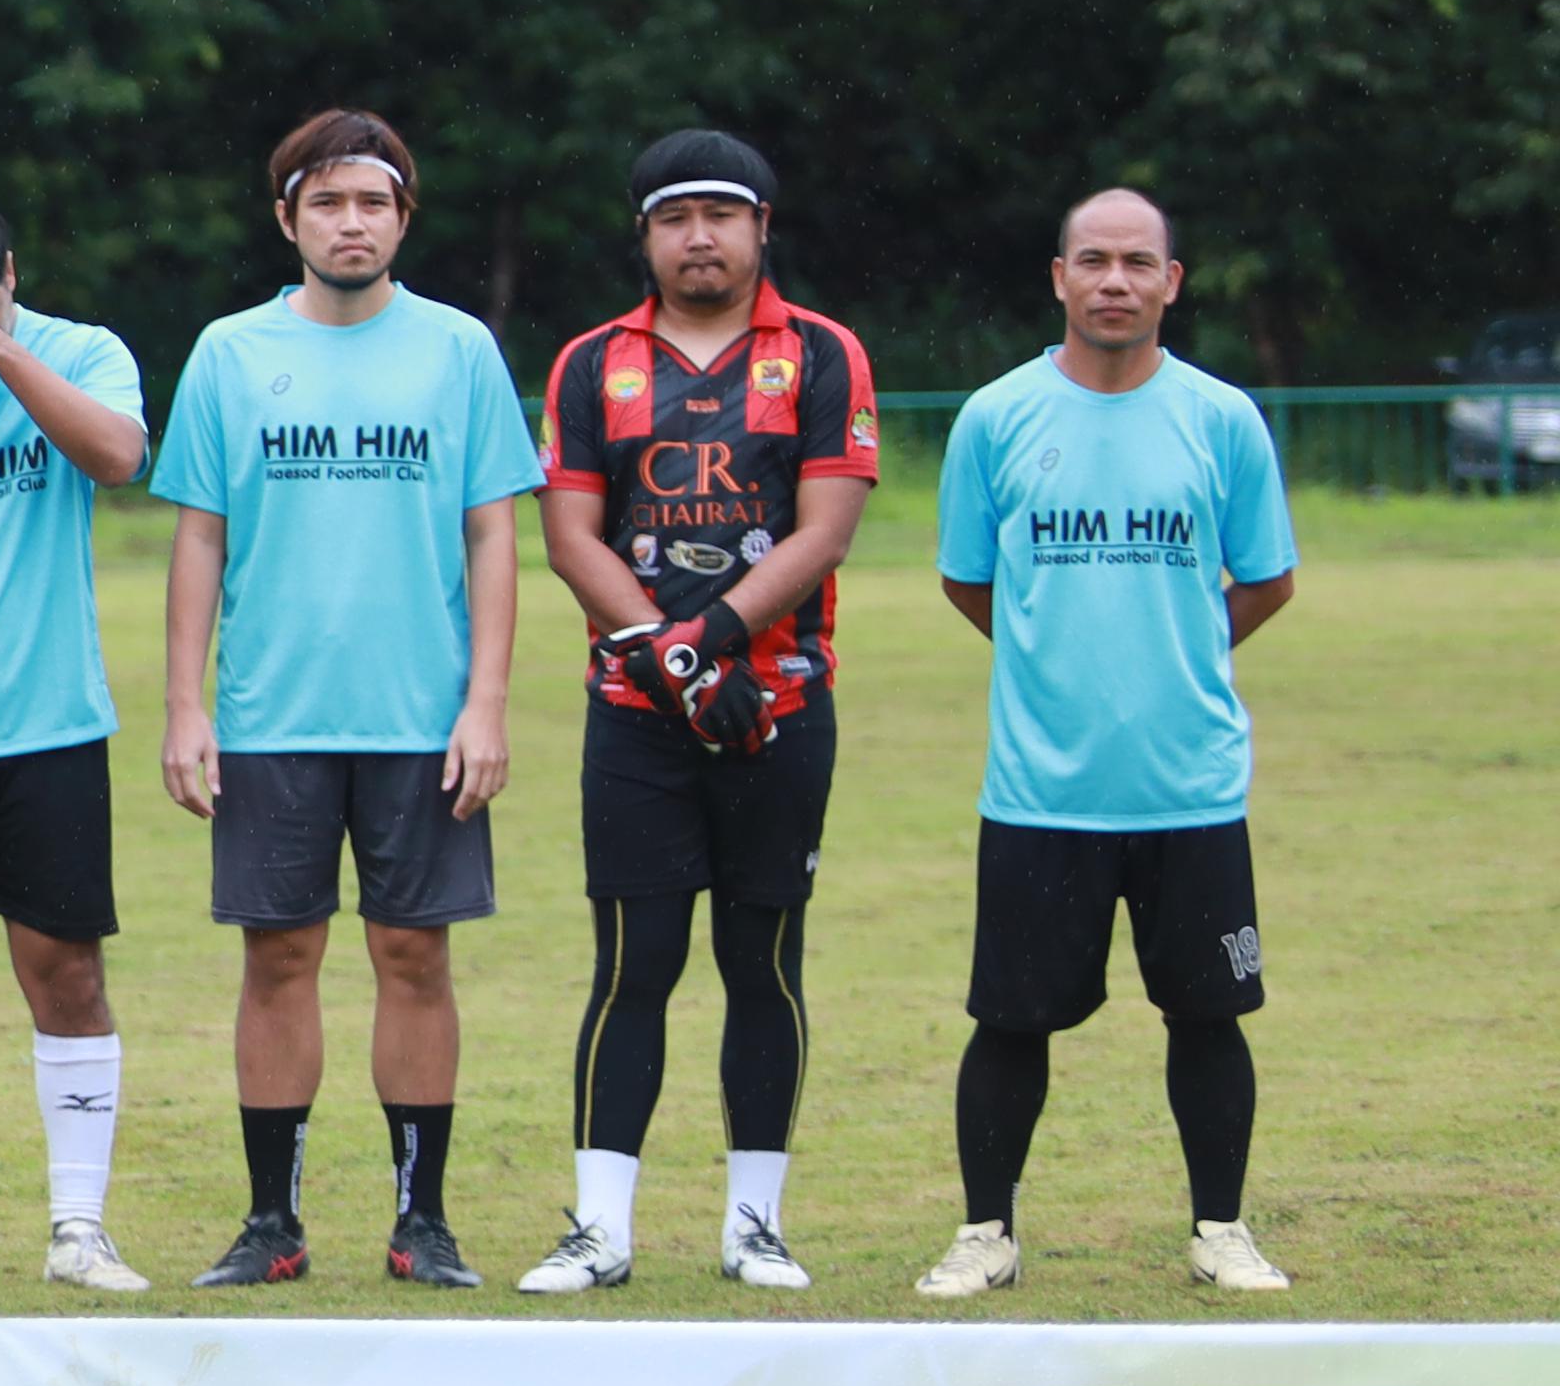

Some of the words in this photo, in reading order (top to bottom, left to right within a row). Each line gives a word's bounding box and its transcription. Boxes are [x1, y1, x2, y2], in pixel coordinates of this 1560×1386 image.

[261, 425, 338, 460] HIM
[356, 425, 429, 462] HIM
[326, 466, 391, 480] Football
[638, 441, 760, 496] CR.
[633, 499, 770, 528] CHAIRAT
[1030, 510, 1108, 545] HIM
[1097, 549, 1160, 564] Football
[1165, 551, 1197, 569] Club
[1220, 924, 1261, 982] 18
